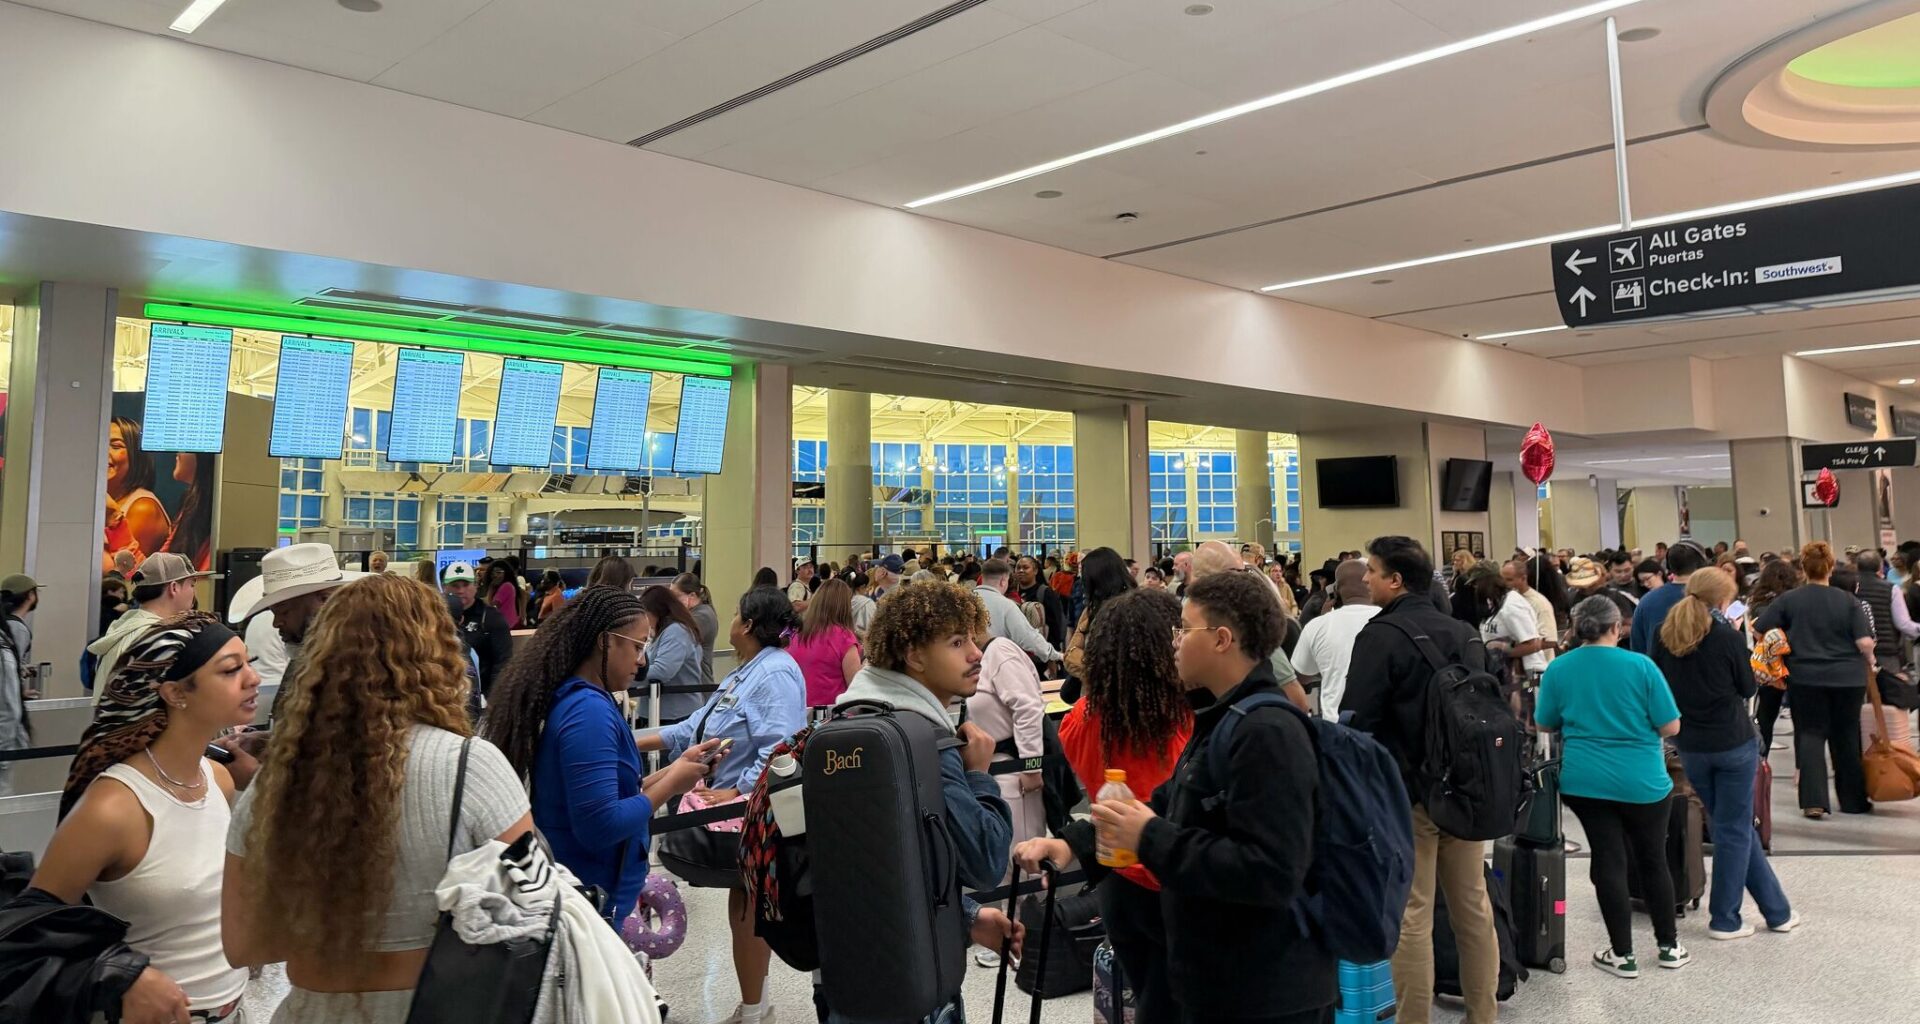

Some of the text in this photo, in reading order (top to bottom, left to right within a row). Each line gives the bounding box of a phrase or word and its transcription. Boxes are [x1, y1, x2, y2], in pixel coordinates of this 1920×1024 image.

[1649, 222, 1747, 250] All Gates
[1649, 249, 1704, 267] Puertas
[1763, 261, 1828, 280] Southwest
[1649, 270, 1749, 296] Check-In:
[153, 326, 185, 336] ARRIVALS
[284, 338, 311, 348] ARRIVALS
[1845, 446, 1869, 455] CLEAR
[1832, 458, 1846, 466] TSA
[823, 747, 864, 775] Bach
[1025, 757, 1042, 770] HOU
